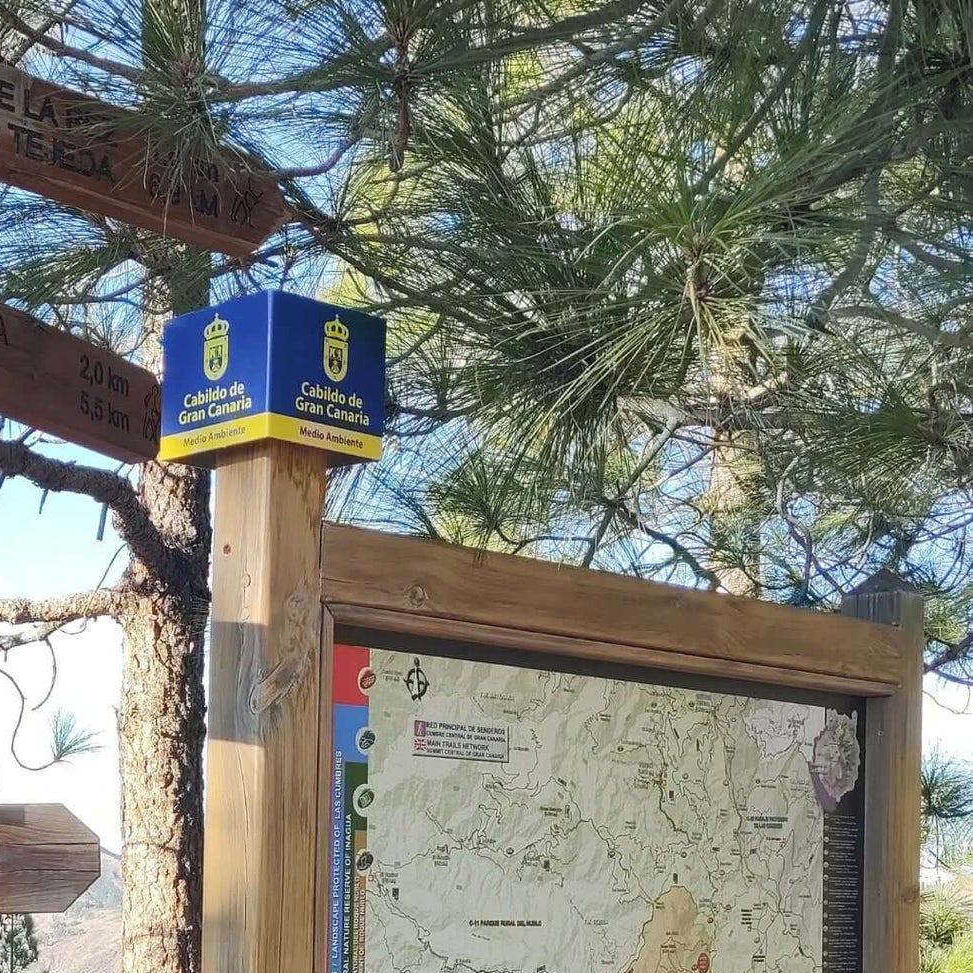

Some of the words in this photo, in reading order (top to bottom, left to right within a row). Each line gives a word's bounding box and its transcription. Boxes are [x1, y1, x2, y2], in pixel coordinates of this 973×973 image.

[24, 88, 59, 126] LA
[8, 122, 116, 184] TEJEDA
[78, 354, 104, 386] 2,0
[107, 366, 129, 398] km
[183, 384, 228, 409] Cabildo
[229, 380, 244, 396] de
[300, 381, 346, 406] Cabildo
[348, 394, 363, 410] de
[78, 392, 106, 424] 5,5
[107, 402, 130, 434] km
[178, 408, 206, 426] Gran
[208, 395, 252, 419] Canaria
[294, 398, 324, 416] Gran
[326, 402, 370, 427] Canaria
[183, 433, 208, 446] Medio
[208, 426, 246, 442] Ambiente
[298, 425, 325, 440] Medio
[325, 433, 364, 449] Ambiente
[438, 722, 467, 732] PRINCIPAL
[462, 742, 490, 751] NETWORK
[334, 824, 340, 838] OF
[345, 853, 351, 866] OF
